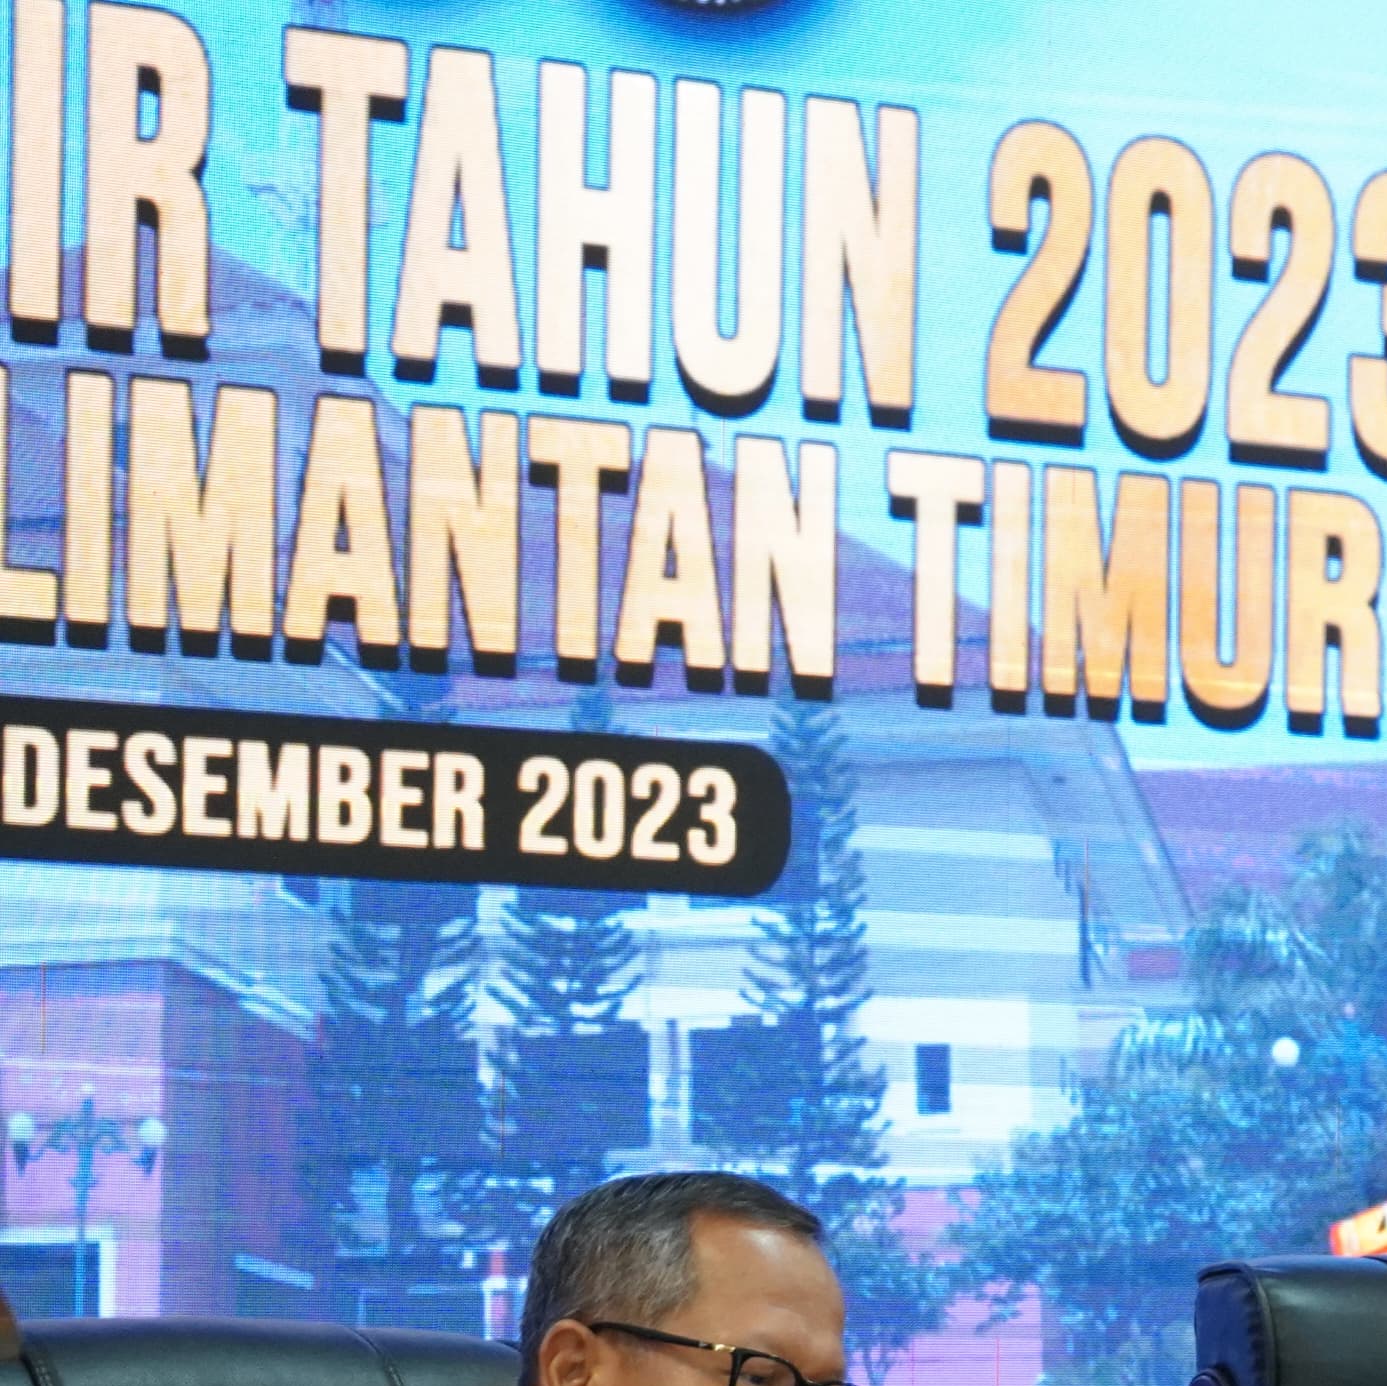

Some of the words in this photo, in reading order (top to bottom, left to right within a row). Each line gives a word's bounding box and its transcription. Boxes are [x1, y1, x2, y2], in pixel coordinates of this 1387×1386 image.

[282, 25, 920, 430] TAHUN
[887, 447, 1386, 739] TIMUR
[3, 724, 485, 851] DESEMBER
[517, 755, 737, 866] 2023
